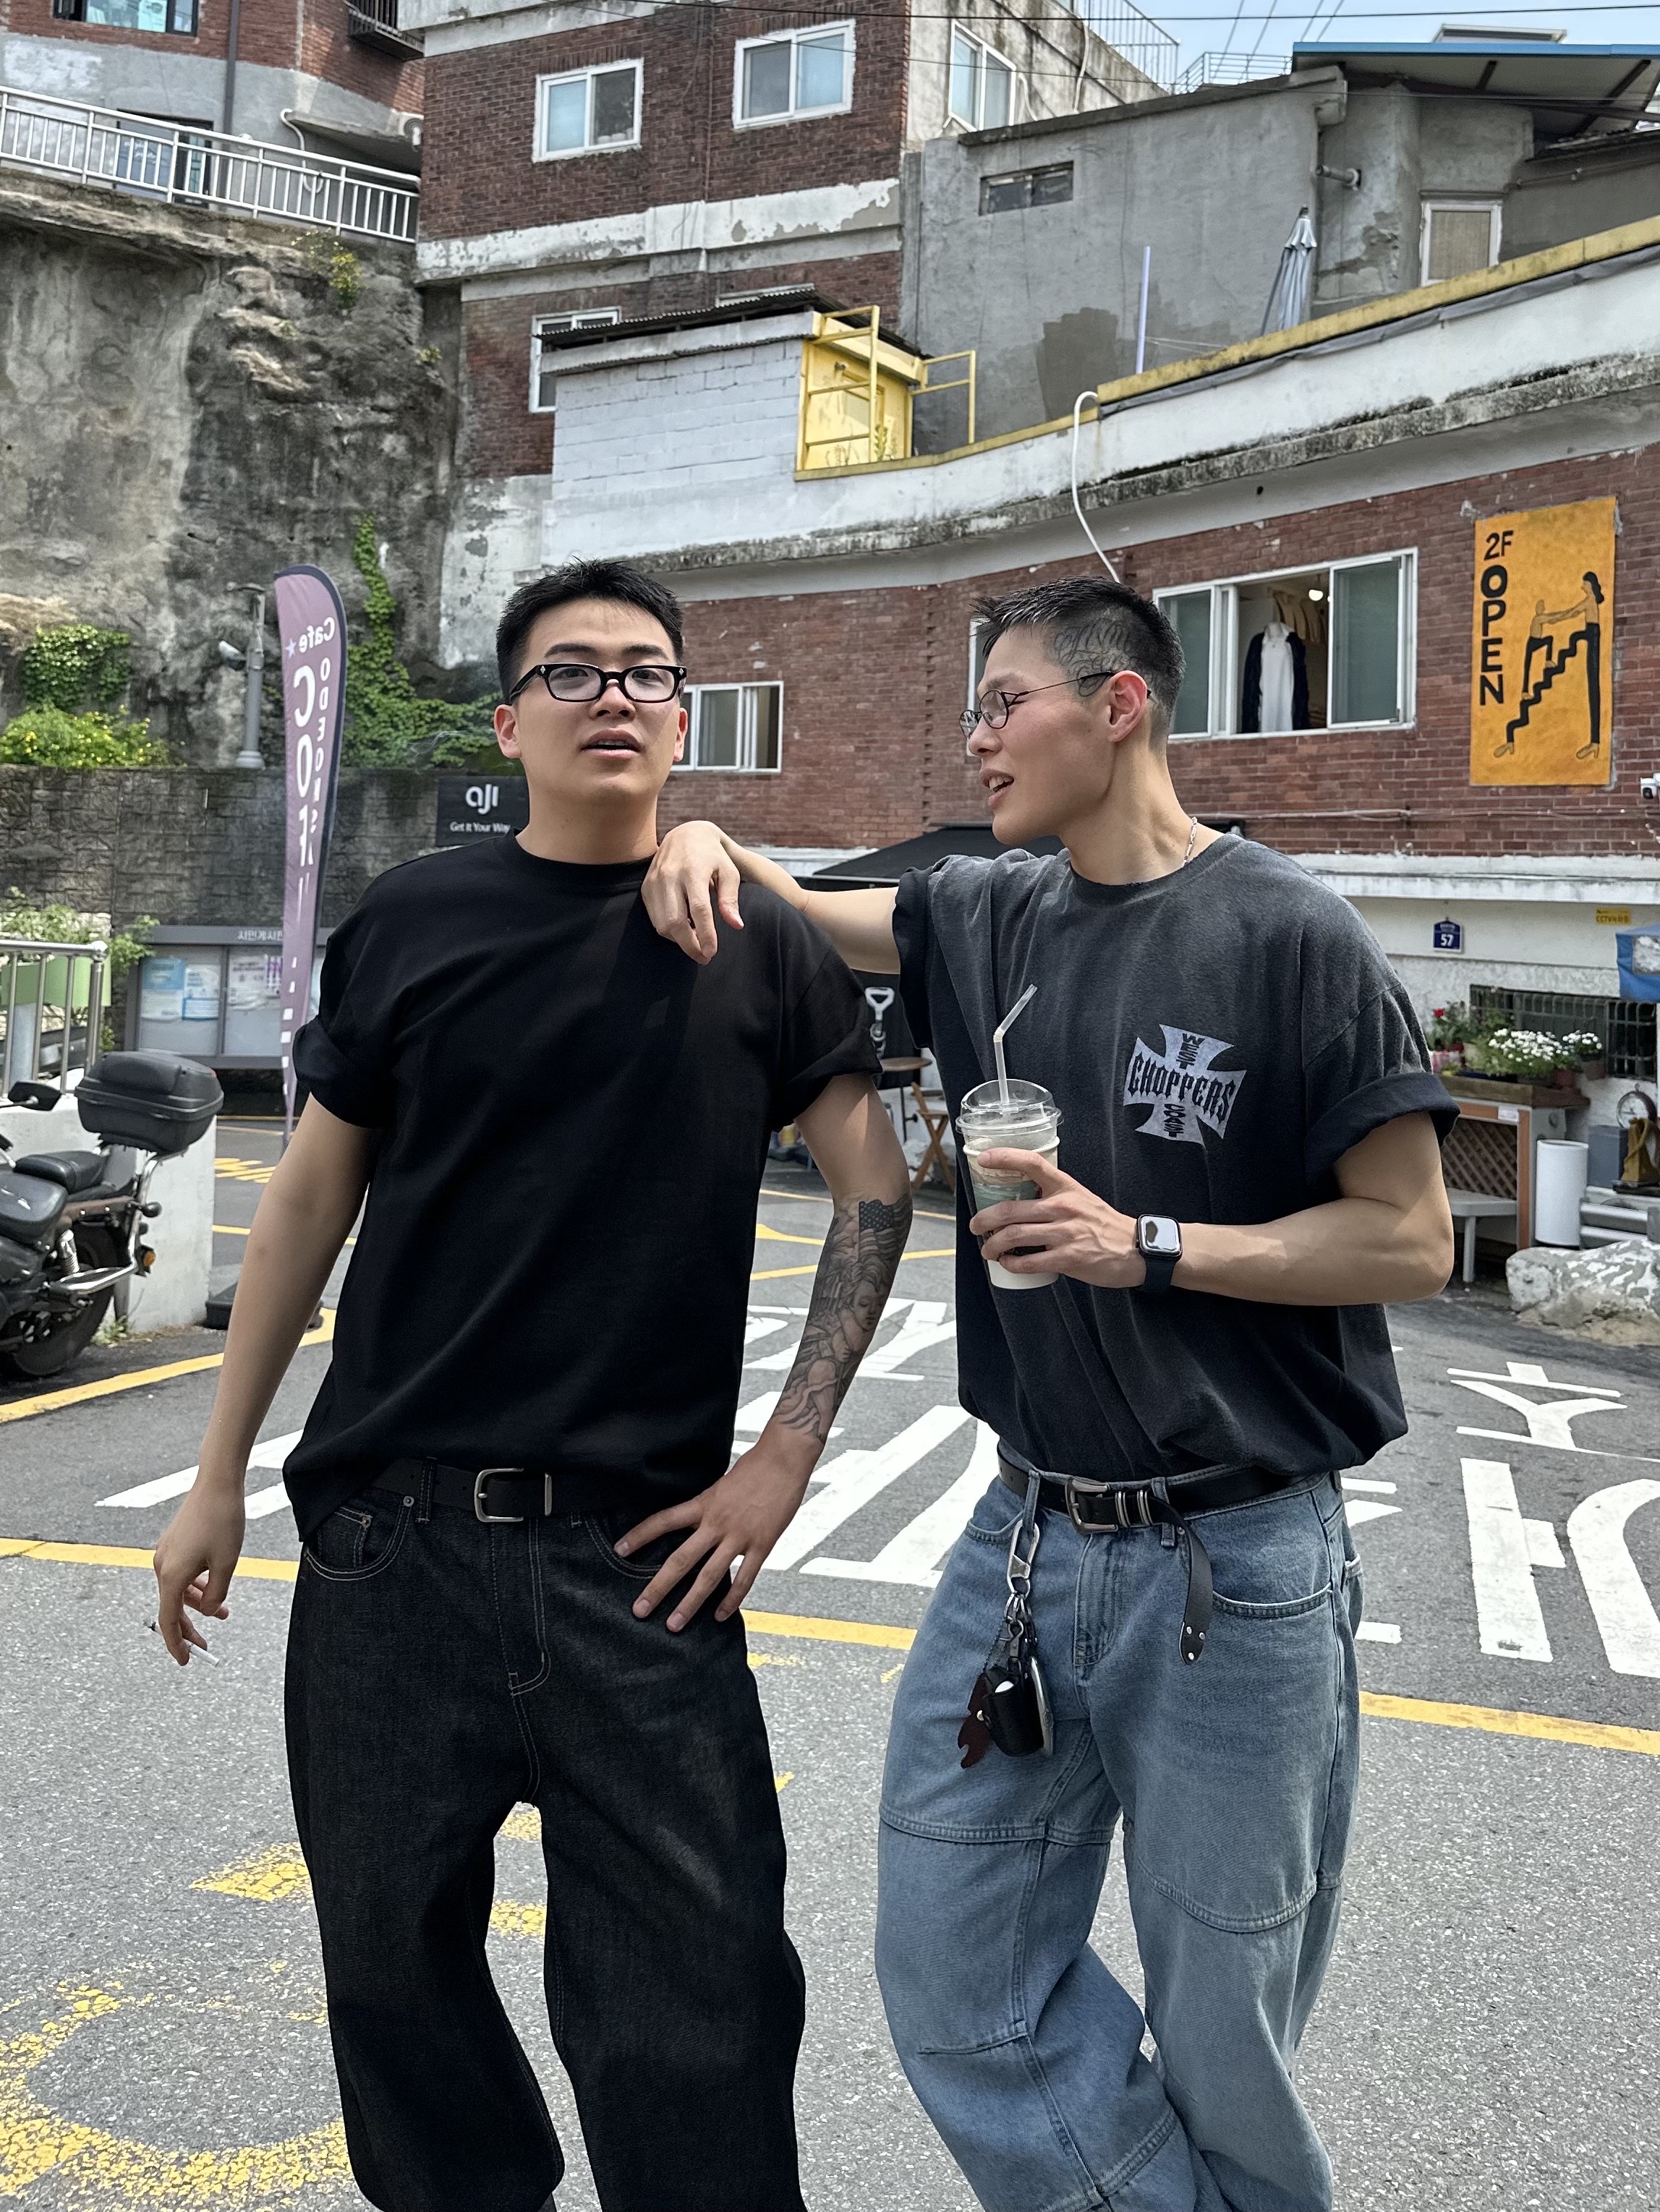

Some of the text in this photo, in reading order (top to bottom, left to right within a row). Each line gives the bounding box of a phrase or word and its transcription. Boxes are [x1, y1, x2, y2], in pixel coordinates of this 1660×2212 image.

[1484, 530, 1514, 560] 2F
[1479, 565, 1508, 706] OPEN
[450, 821, 465, 832] Get
[473, 822, 491, 832] Your
[493, 822, 511, 834] Way
[1440, 934, 1454, 947] 57
[1175, 1033, 1205, 1069] WEST
[1127, 1051, 1237, 1125] CHOPPERS
[1163, 1103, 1186, 1137] COAST
